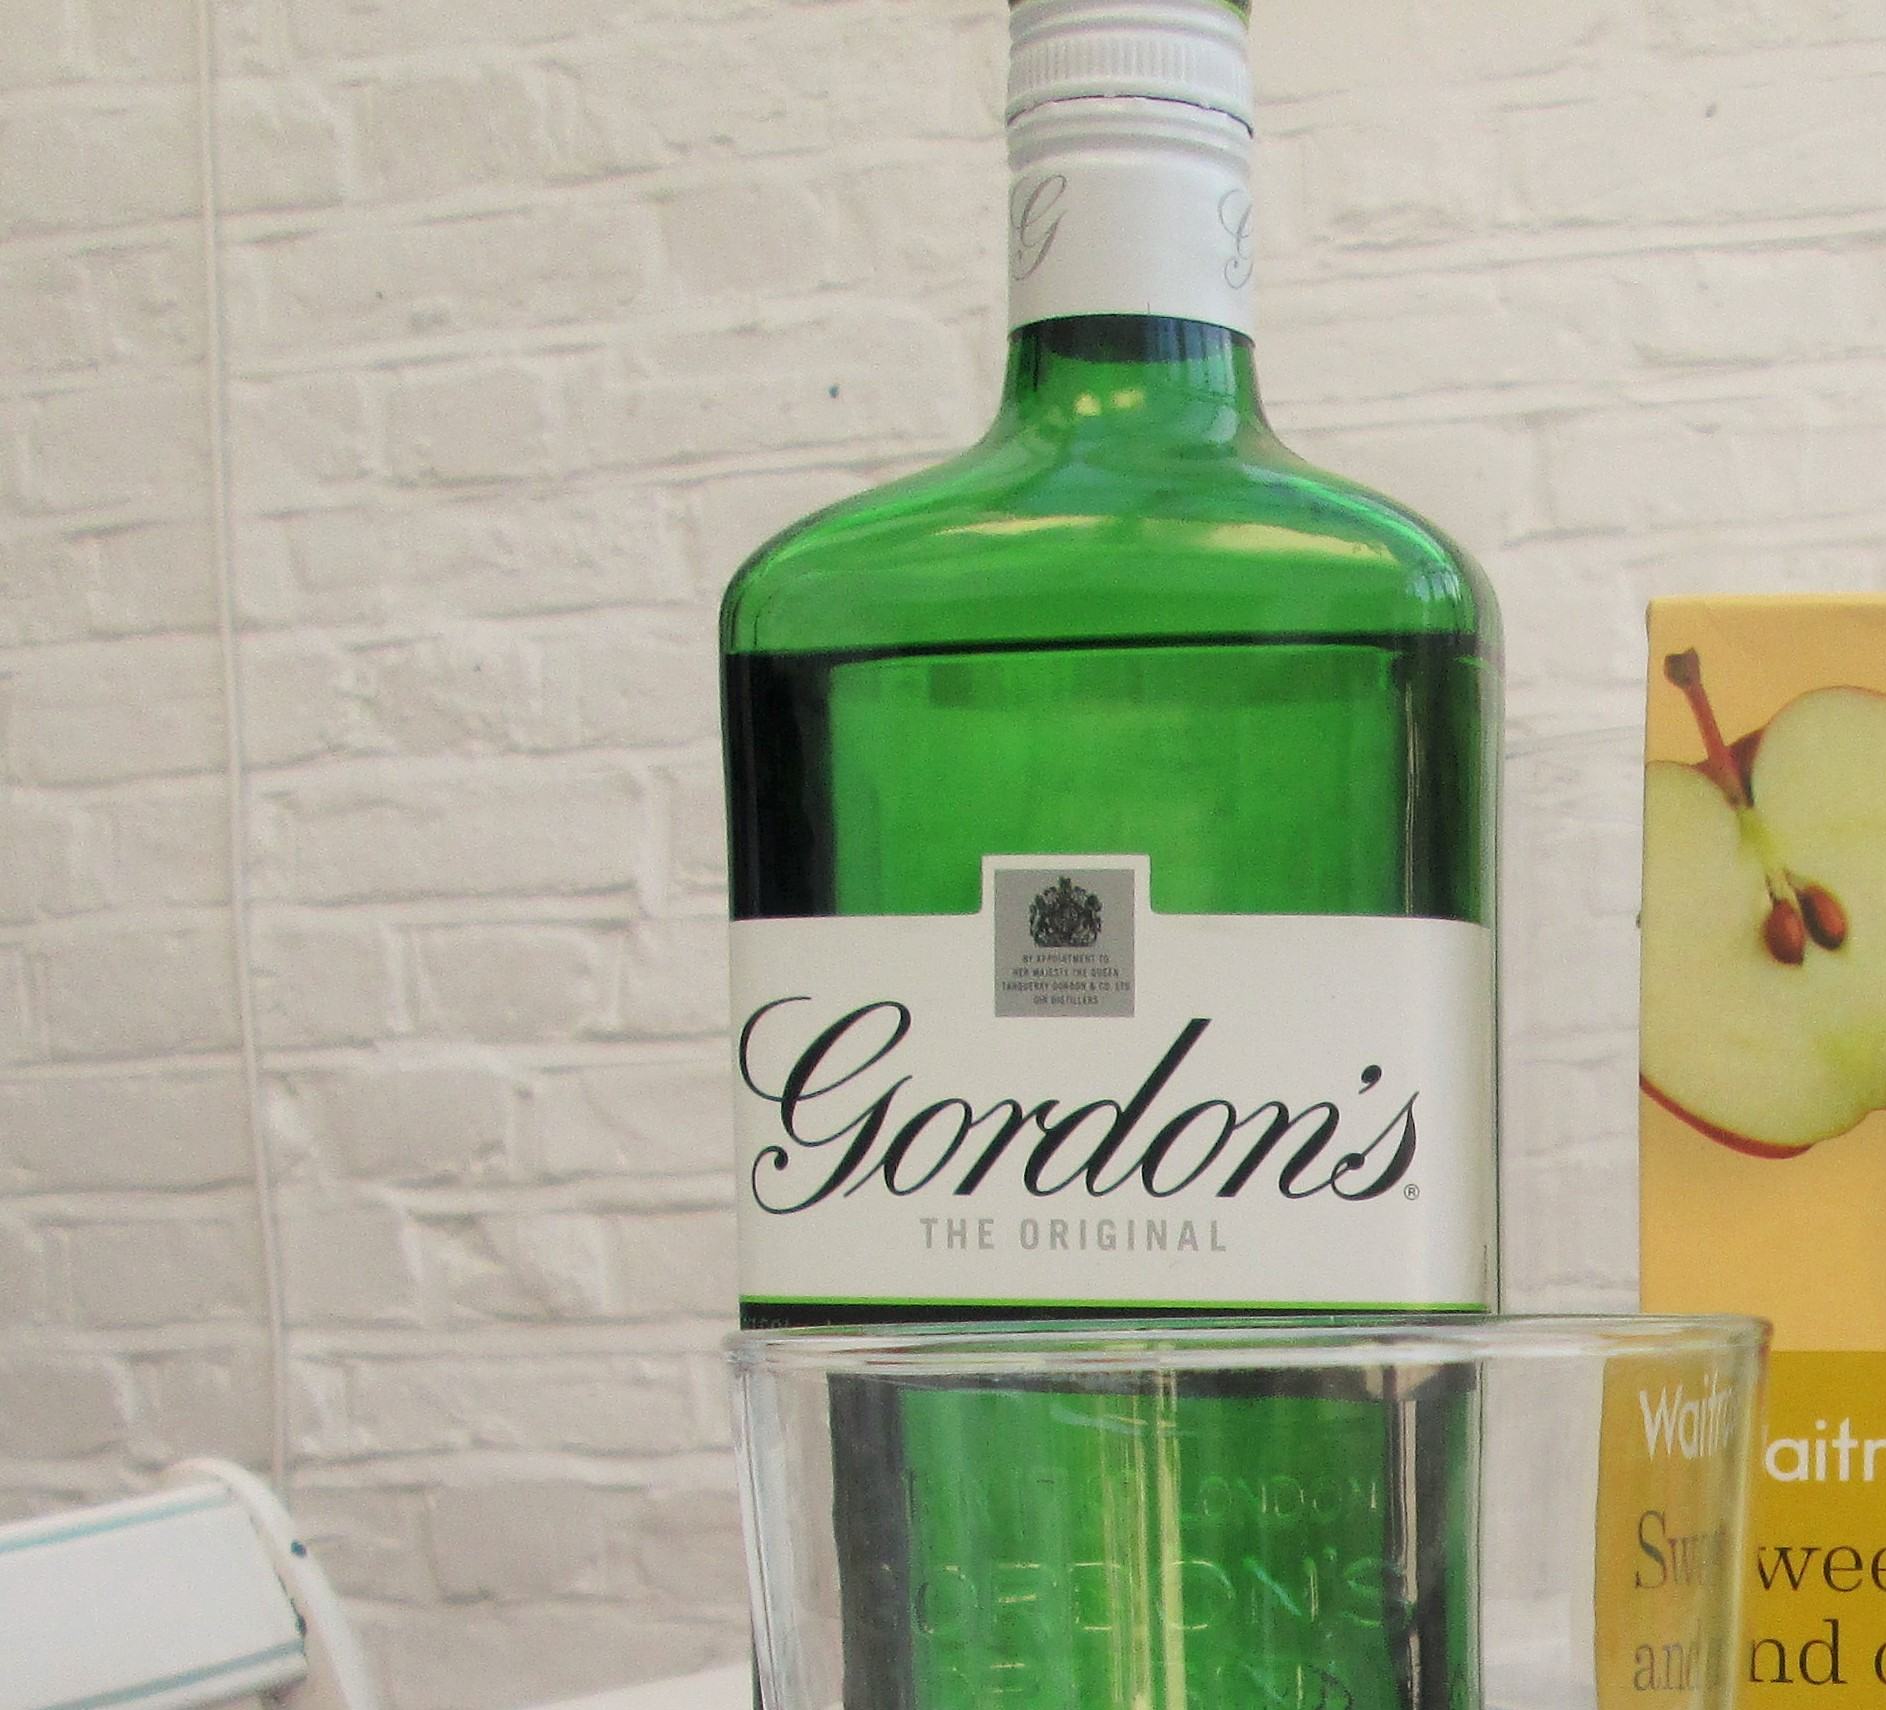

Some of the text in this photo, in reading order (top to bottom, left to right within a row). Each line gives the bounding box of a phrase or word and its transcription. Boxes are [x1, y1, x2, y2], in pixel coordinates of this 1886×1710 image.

[738, 995, 1421, 1215] Gordon's
[919, 1218, 1228, 1253] THE ORIGINAL
[1748, 1619, 1847, 1686] nd
